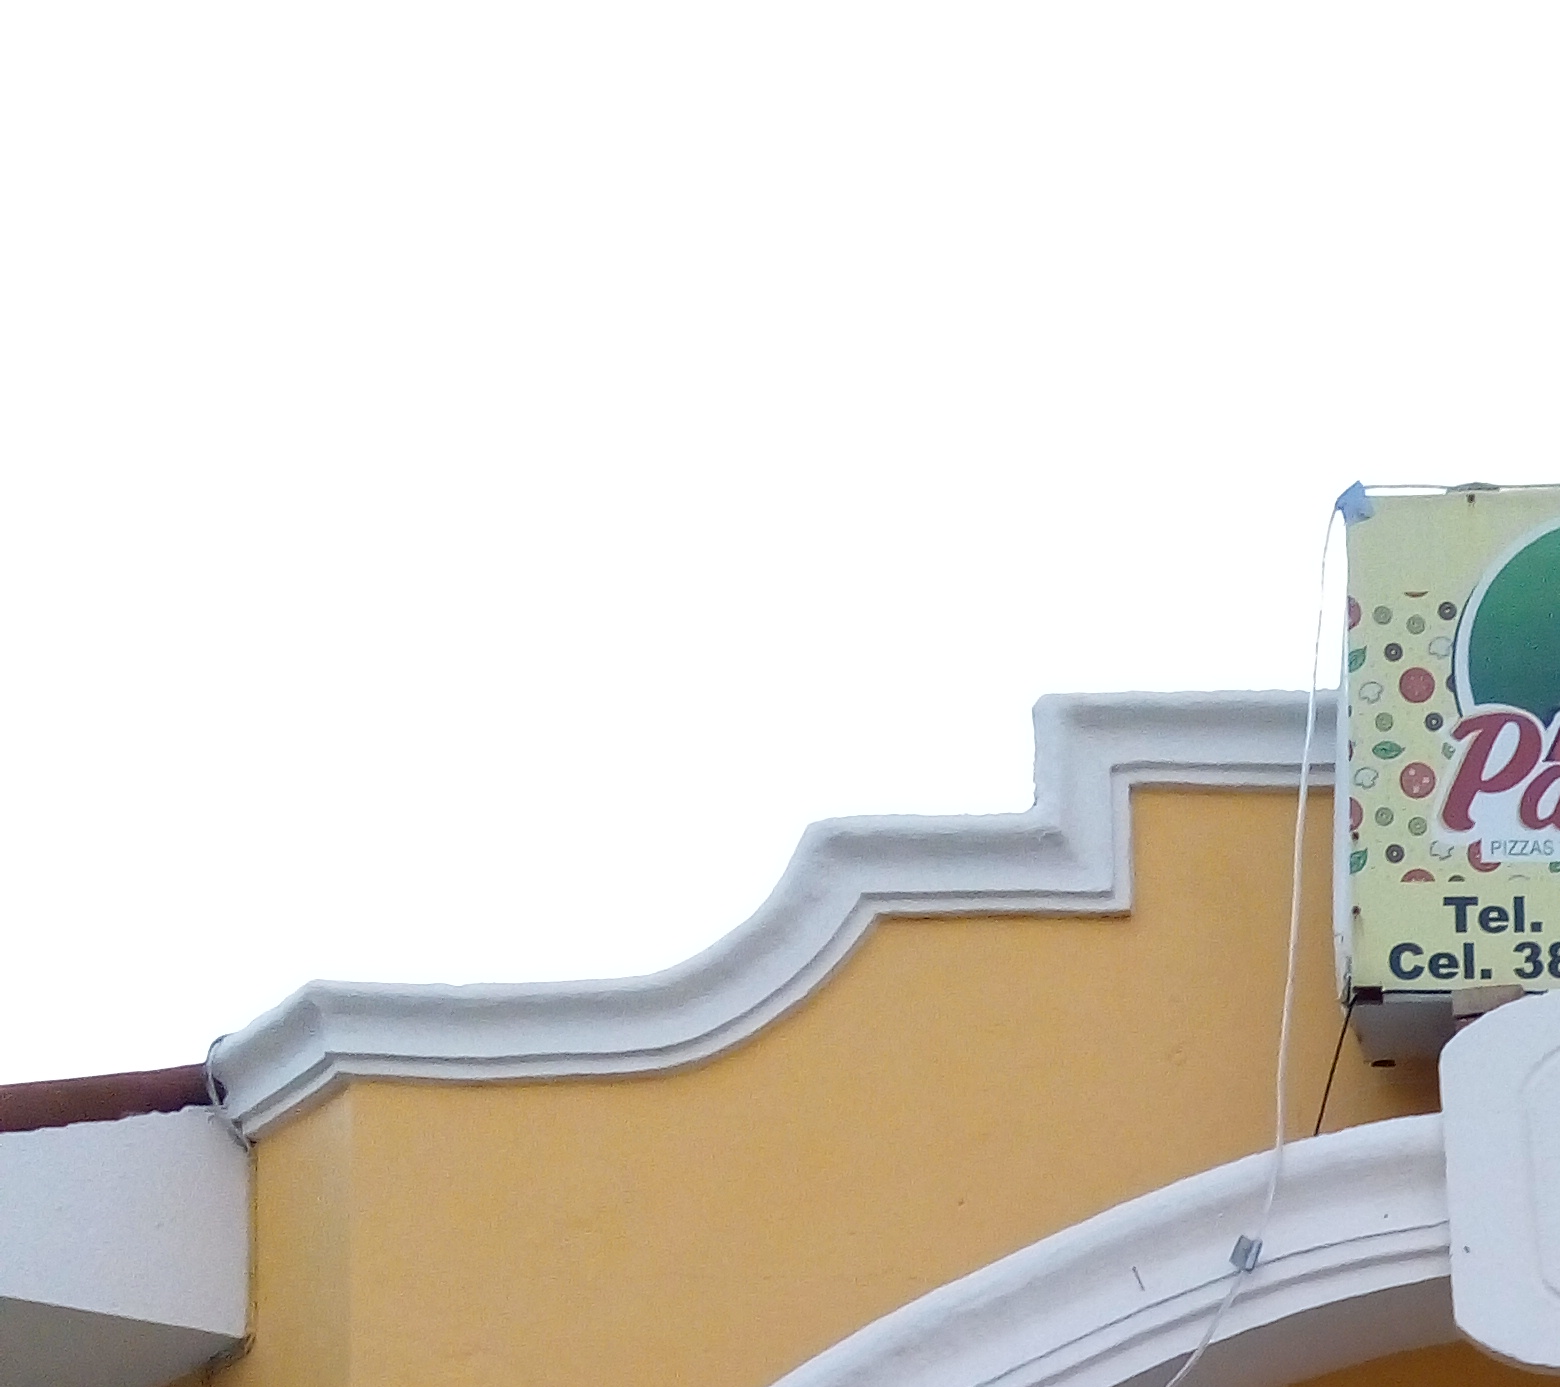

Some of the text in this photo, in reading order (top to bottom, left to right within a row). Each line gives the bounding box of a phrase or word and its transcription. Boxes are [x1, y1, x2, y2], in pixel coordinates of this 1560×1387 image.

[1490, 839, 1555, 857] PIZZAS
[1442, 895, 1544, 934] Tel.
[1388, 941, 1492, 980] Cel.
